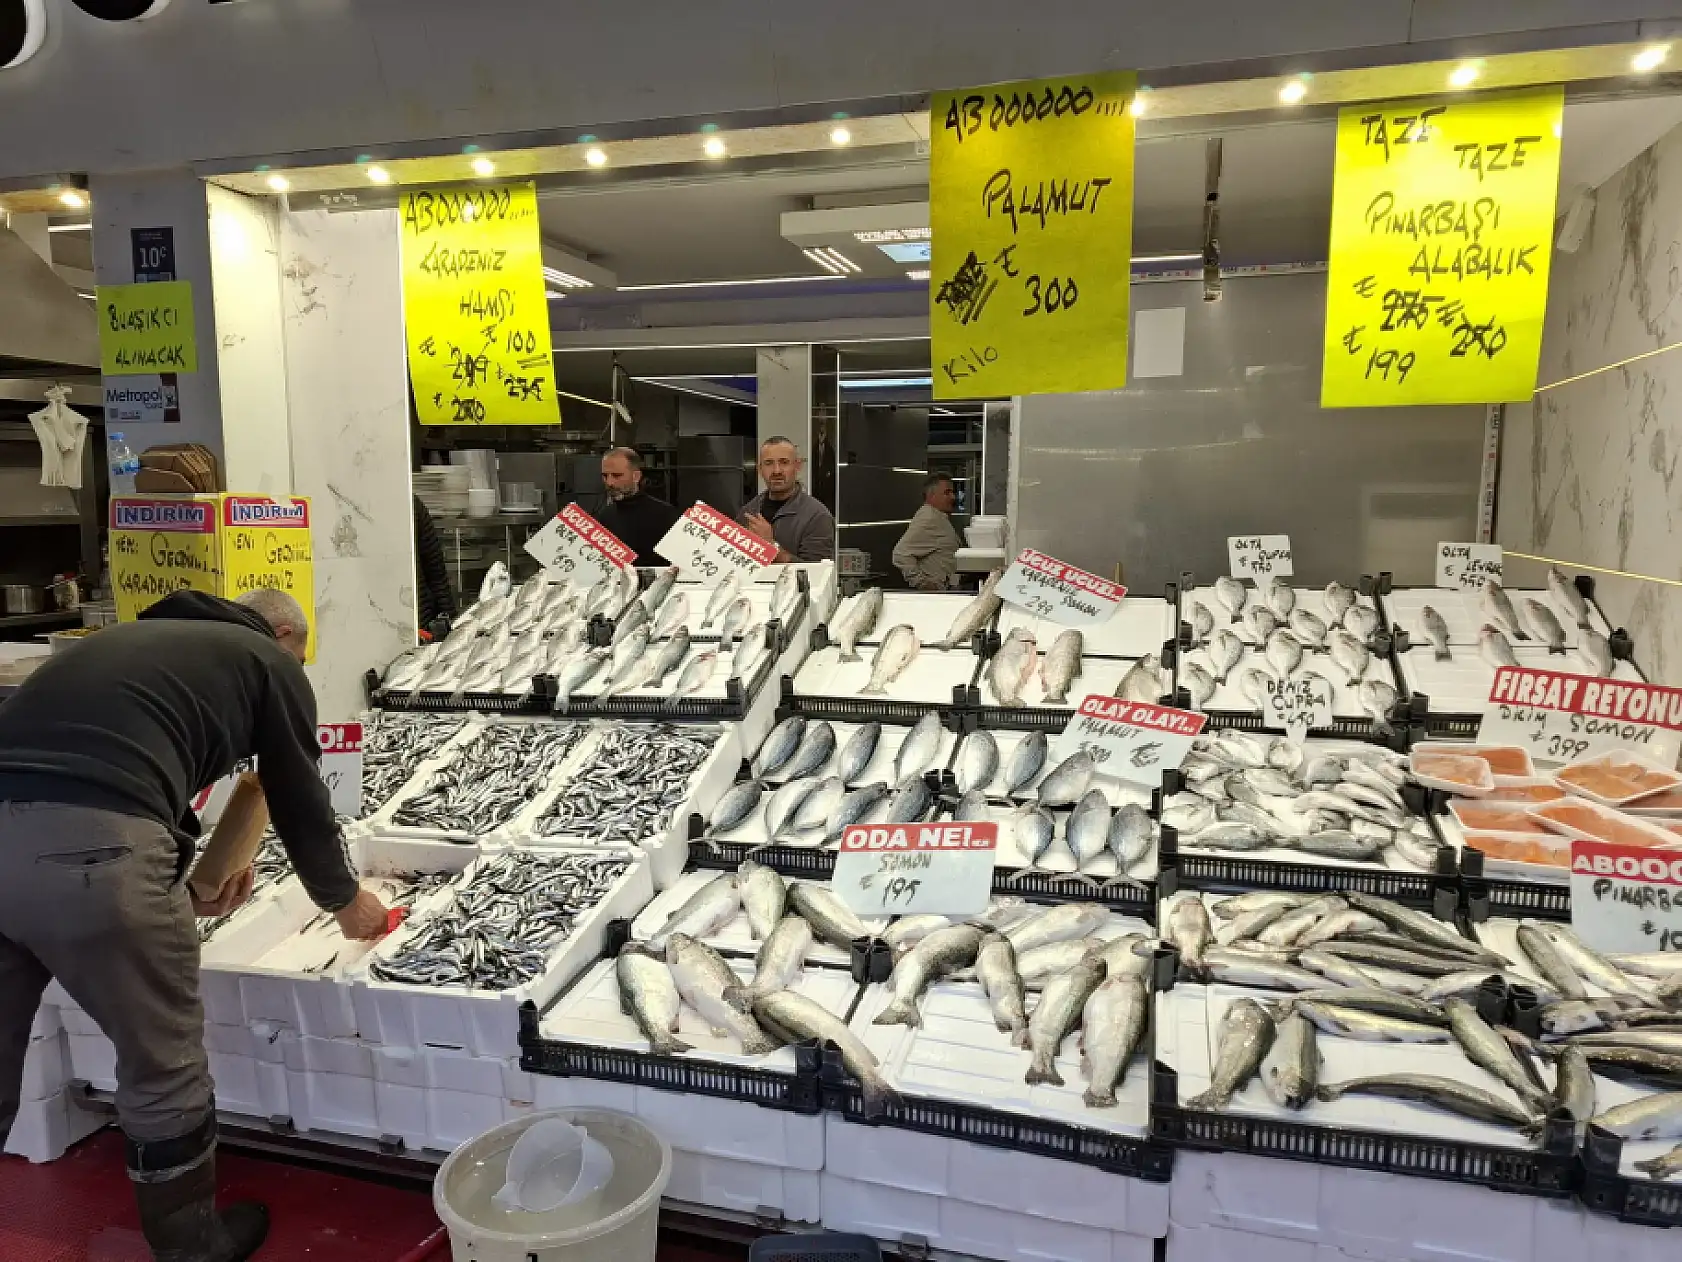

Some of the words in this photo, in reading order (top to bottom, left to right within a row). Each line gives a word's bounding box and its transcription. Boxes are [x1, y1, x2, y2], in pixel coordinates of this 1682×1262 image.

[1359, 106, 1447, 163] TAZE
[1454, 136, 1542, 181] TAZE
[982, 168, 1112, 234] PALAMUT
[1408, 241, 1538, 283] ALABALIK
[1022, 274, 1078, 316] 300
[506, 329, 536, 354] 100
[1365, 348, 1416, 385] 199
[105, 388, 163, 404] Metropol
[115, 501, 205, 524] İNDİRİM
[1441, 545, 1470, 560] OLTA
[1494, 670, 1580, 710] FIRSAT
[1083, 698, 1132, 719] OLAY
[1570, 713, 1656, 743] SOMON
[847, 828, 908, 849] ODA
[882, 876, 922, 908] 195
